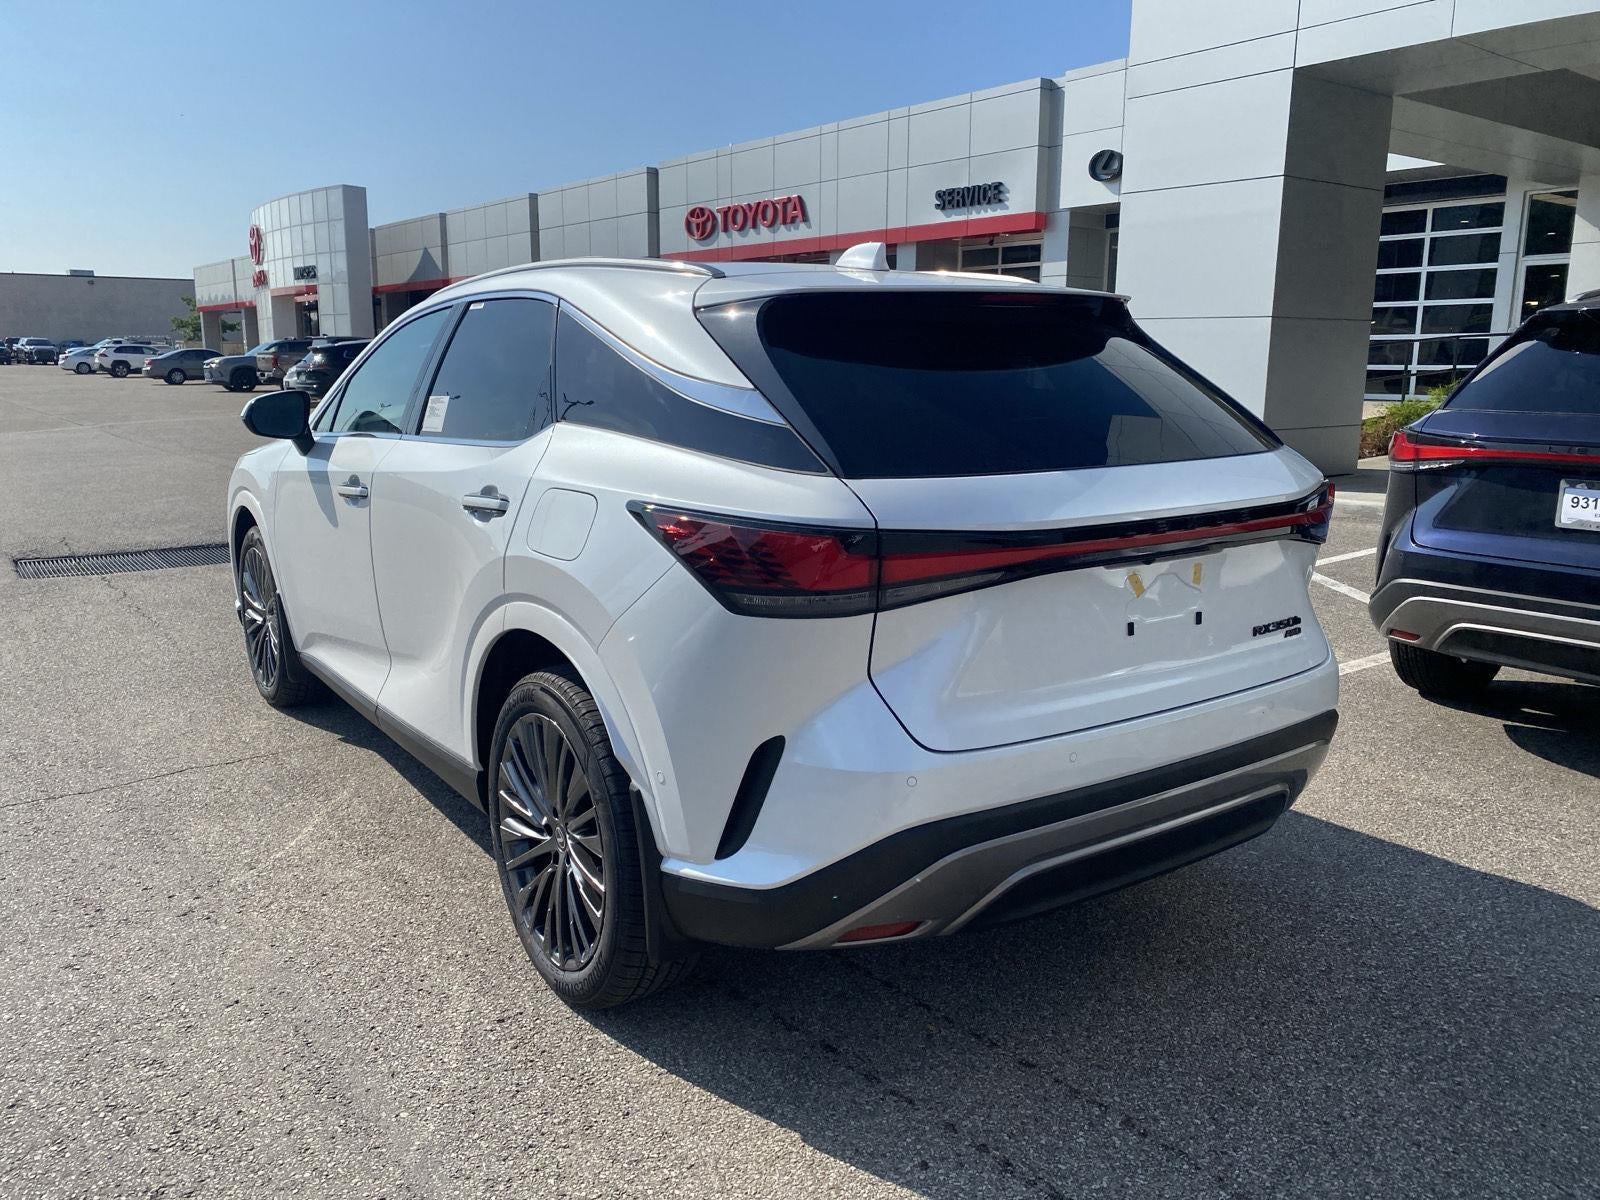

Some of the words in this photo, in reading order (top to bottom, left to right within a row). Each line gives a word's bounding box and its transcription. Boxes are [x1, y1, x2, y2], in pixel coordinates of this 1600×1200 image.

[935, 182, 1005, 210] SERVICE
[716, 195, 805, 232] TOYOTA
[1571, 496, 1599, 510] 931
